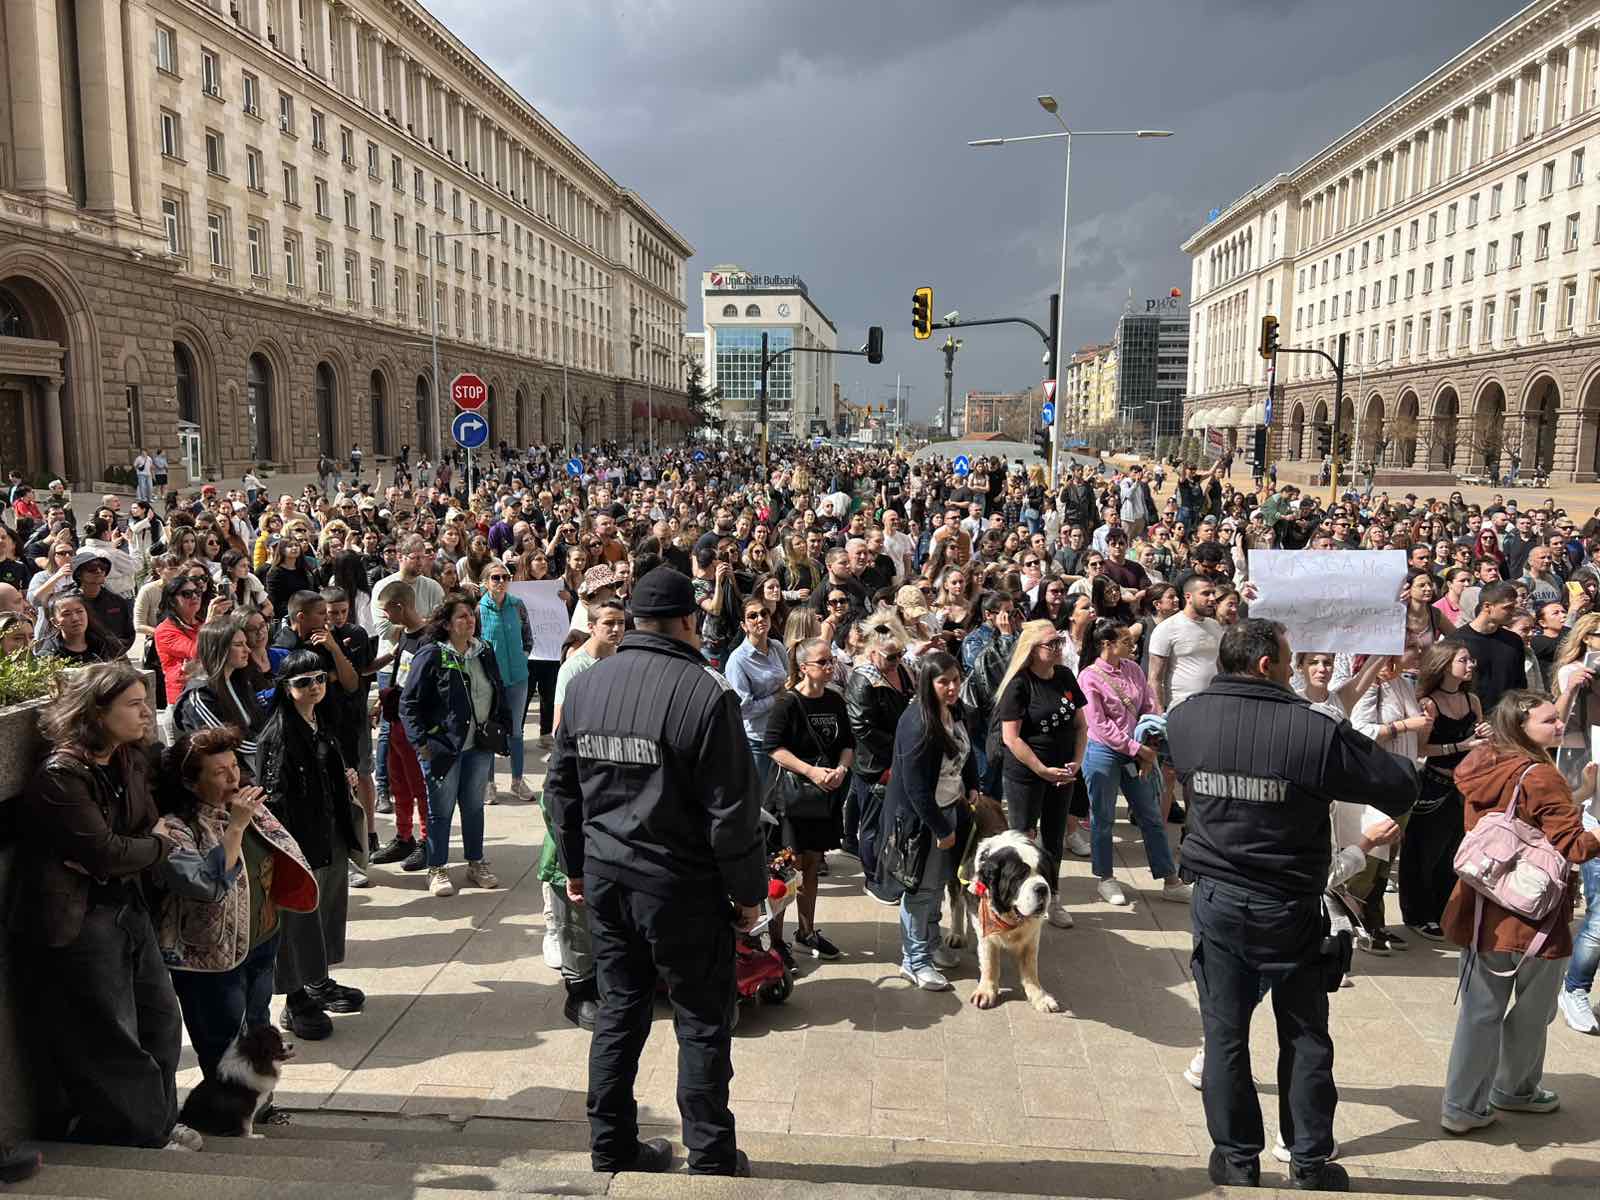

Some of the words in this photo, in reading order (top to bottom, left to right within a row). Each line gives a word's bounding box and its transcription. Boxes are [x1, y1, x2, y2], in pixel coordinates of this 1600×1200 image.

[764, 274, 801, 286] Bulbank
[455, 385, 483, 399] STOP
[577, 734, 658, 764] GENDARMERY
[1193, 771, 1287, 802] GENDARMERY
